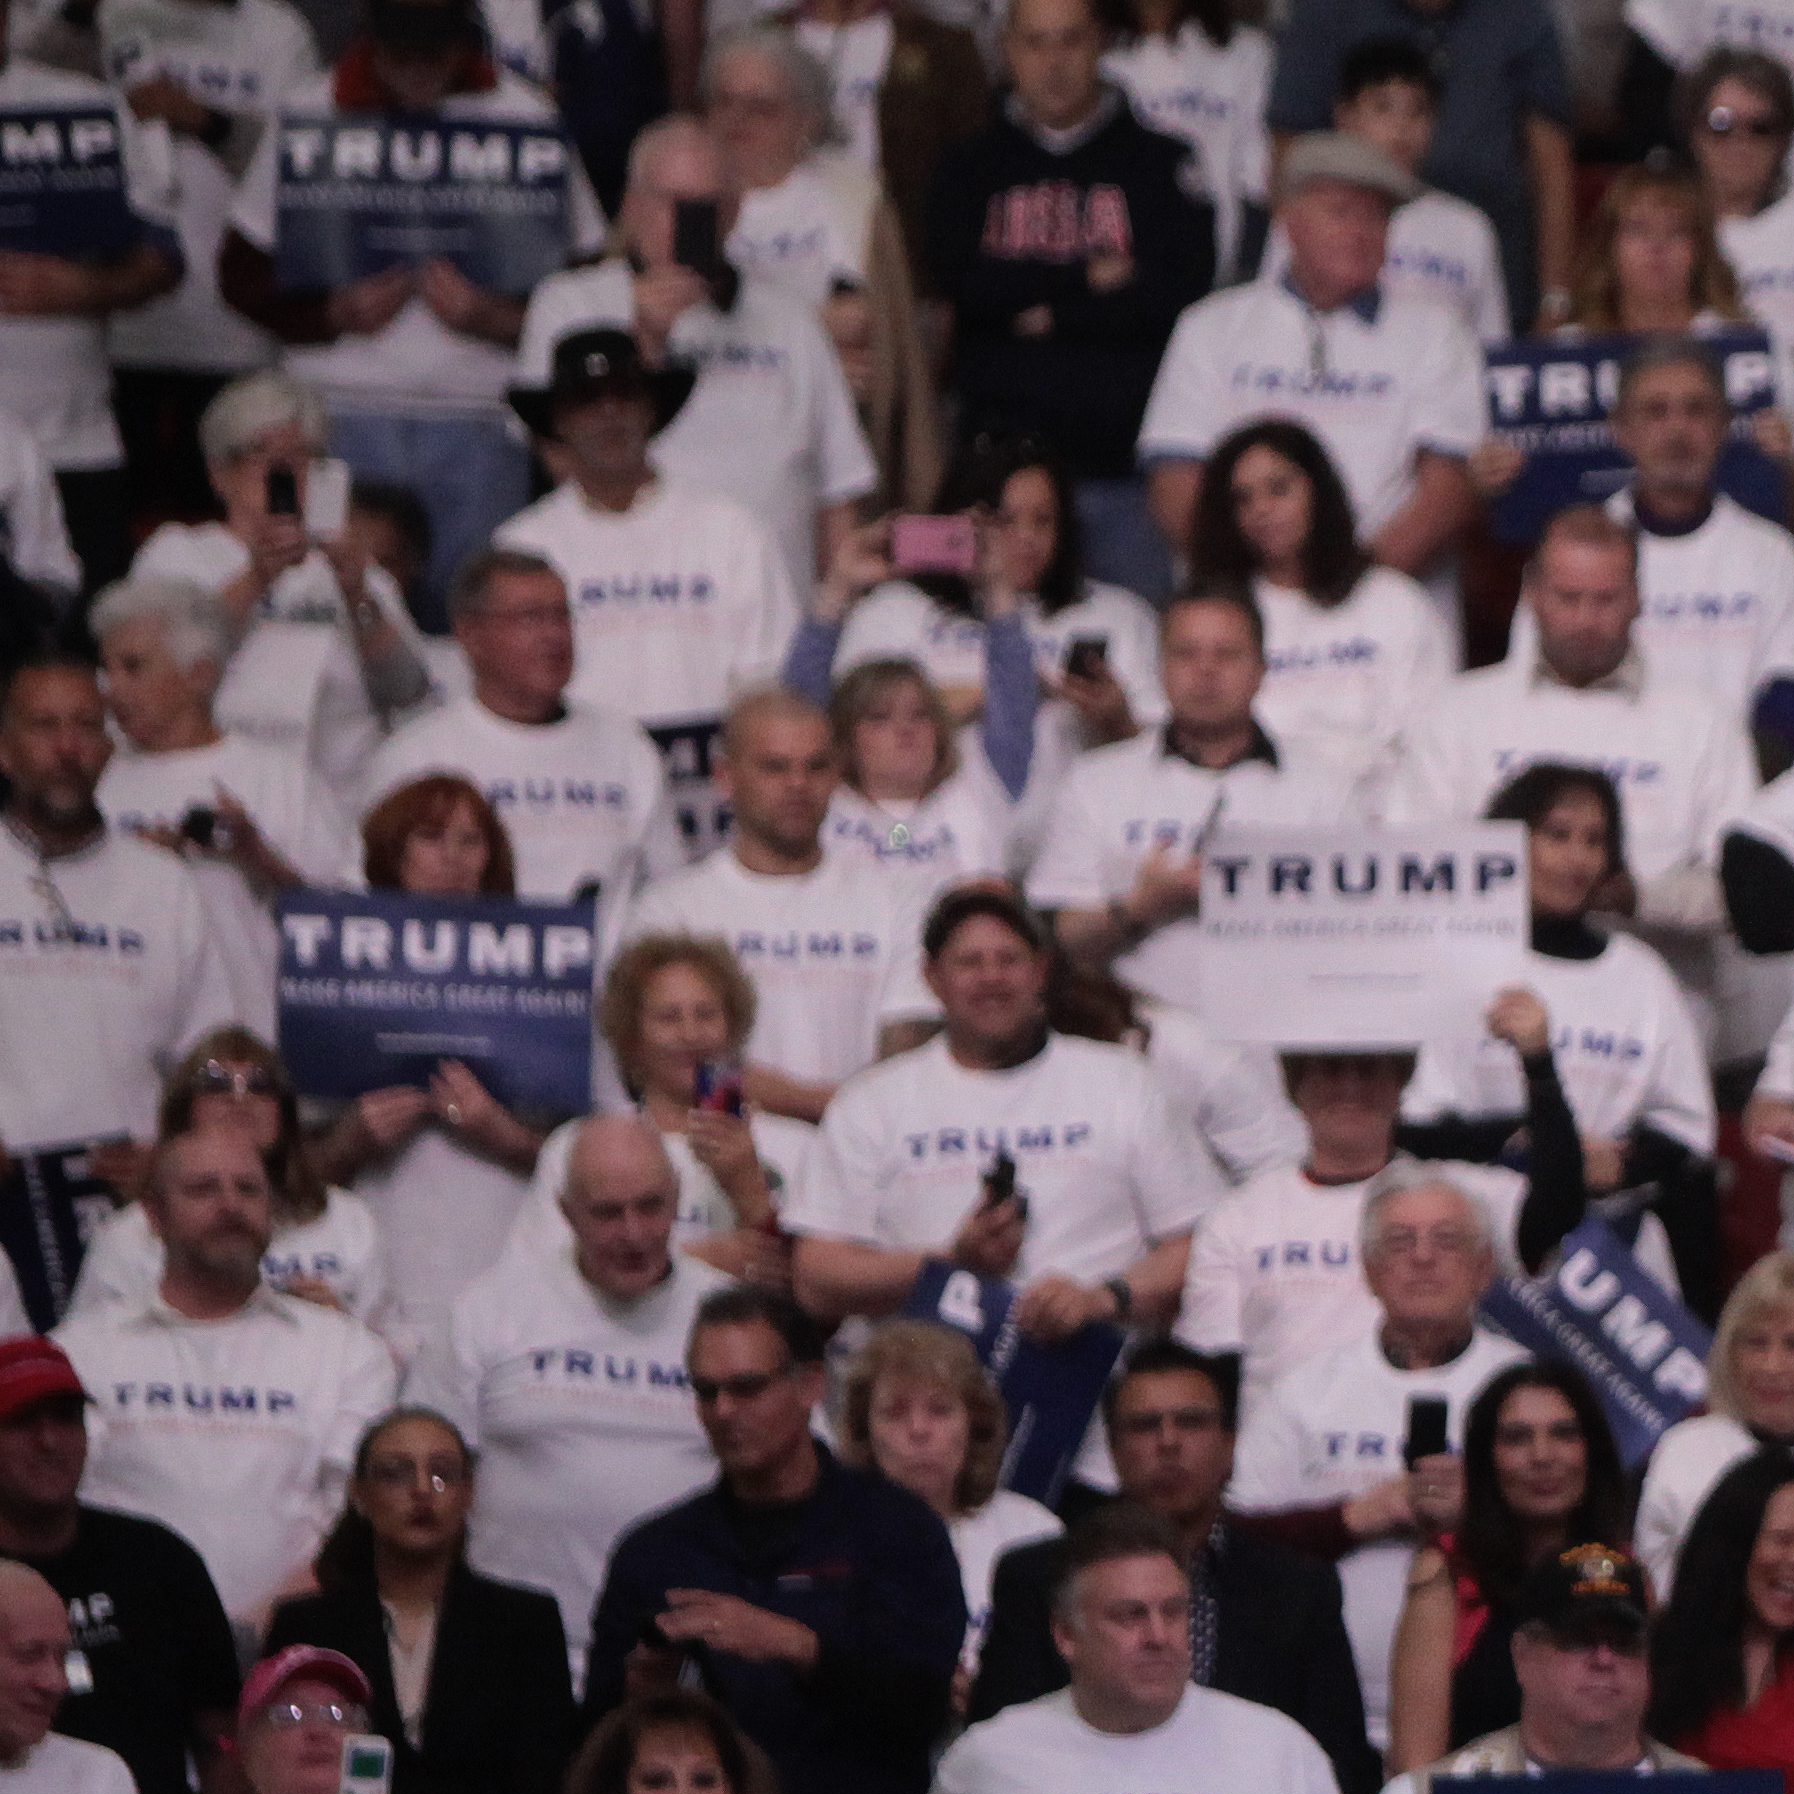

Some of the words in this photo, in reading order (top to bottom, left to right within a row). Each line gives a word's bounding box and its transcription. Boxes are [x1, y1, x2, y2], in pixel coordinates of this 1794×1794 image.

[283, 127, 567, 184] TRUMP
[1492, 353, 1771, 413] TRP
[581, 574, 714, 604] RUMP
[1210, 855, 1518, 897] TRUMP
[0, 922, 144, 952] RUMP
[282, 913, 592, 978] TRUMP
[737, 933, 879, 959] RUMP
[905, 1124, 1091, 1158] TRUMP
[1255, 1243, 1351, 1271] TRU
[1556, 1247, 1711, 1412] UMP
[114, 1383, 296, 1415] TRUMP
